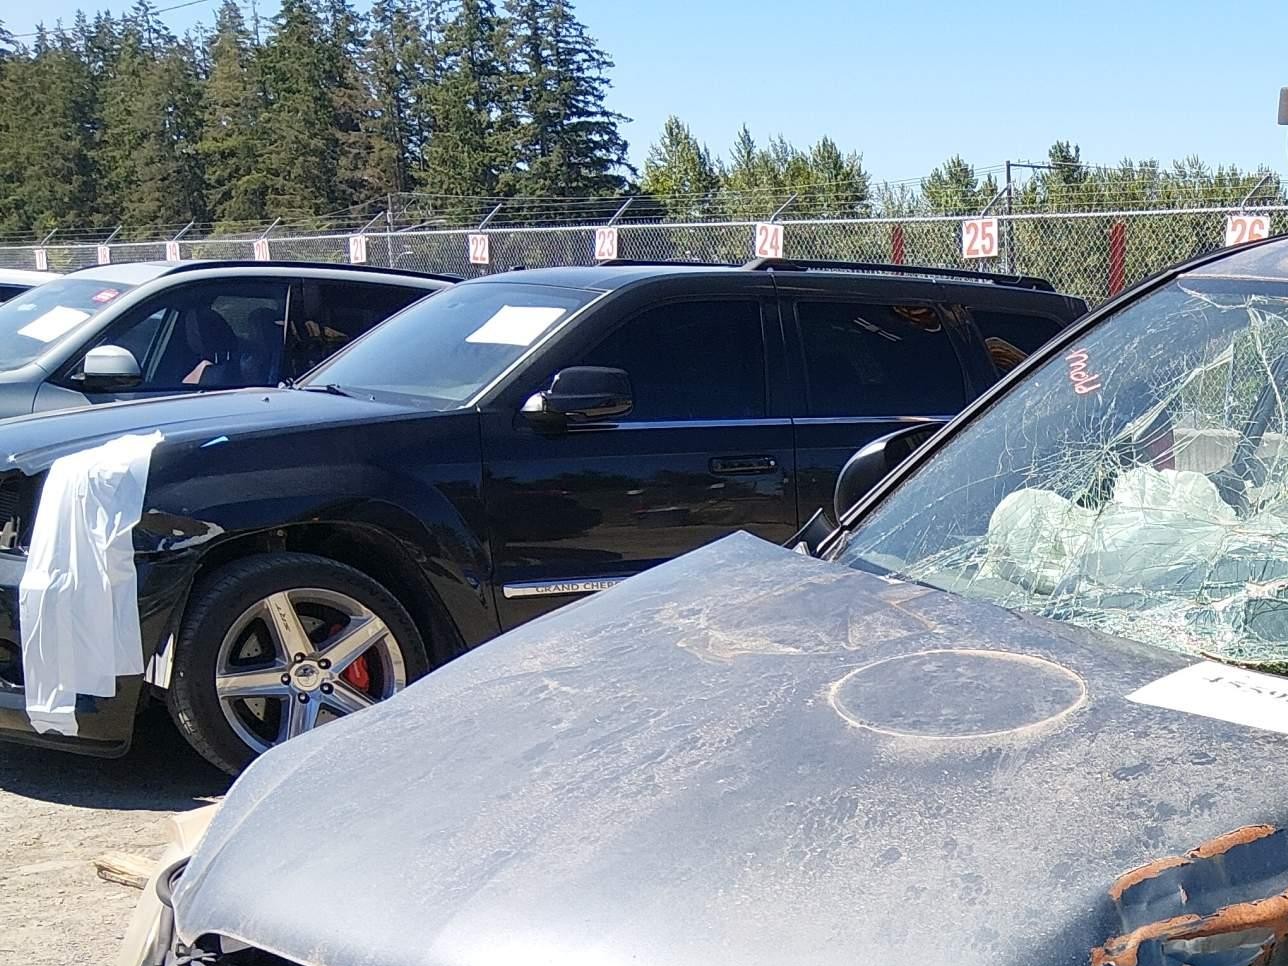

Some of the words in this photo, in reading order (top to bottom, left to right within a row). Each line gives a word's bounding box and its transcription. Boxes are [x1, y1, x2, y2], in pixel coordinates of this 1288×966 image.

[597, 229, 615, 257] 23
[759, 225, 781, 257] 24
[964, 221, 995, 256] 25
[1231, 218, 1265, 243] 26
[352, 237, 364, 260] 21
[471, 235, 487, 261] 22
[535, 583, 580, 593] GRAND
[583, 581, 621, 591] CHER
